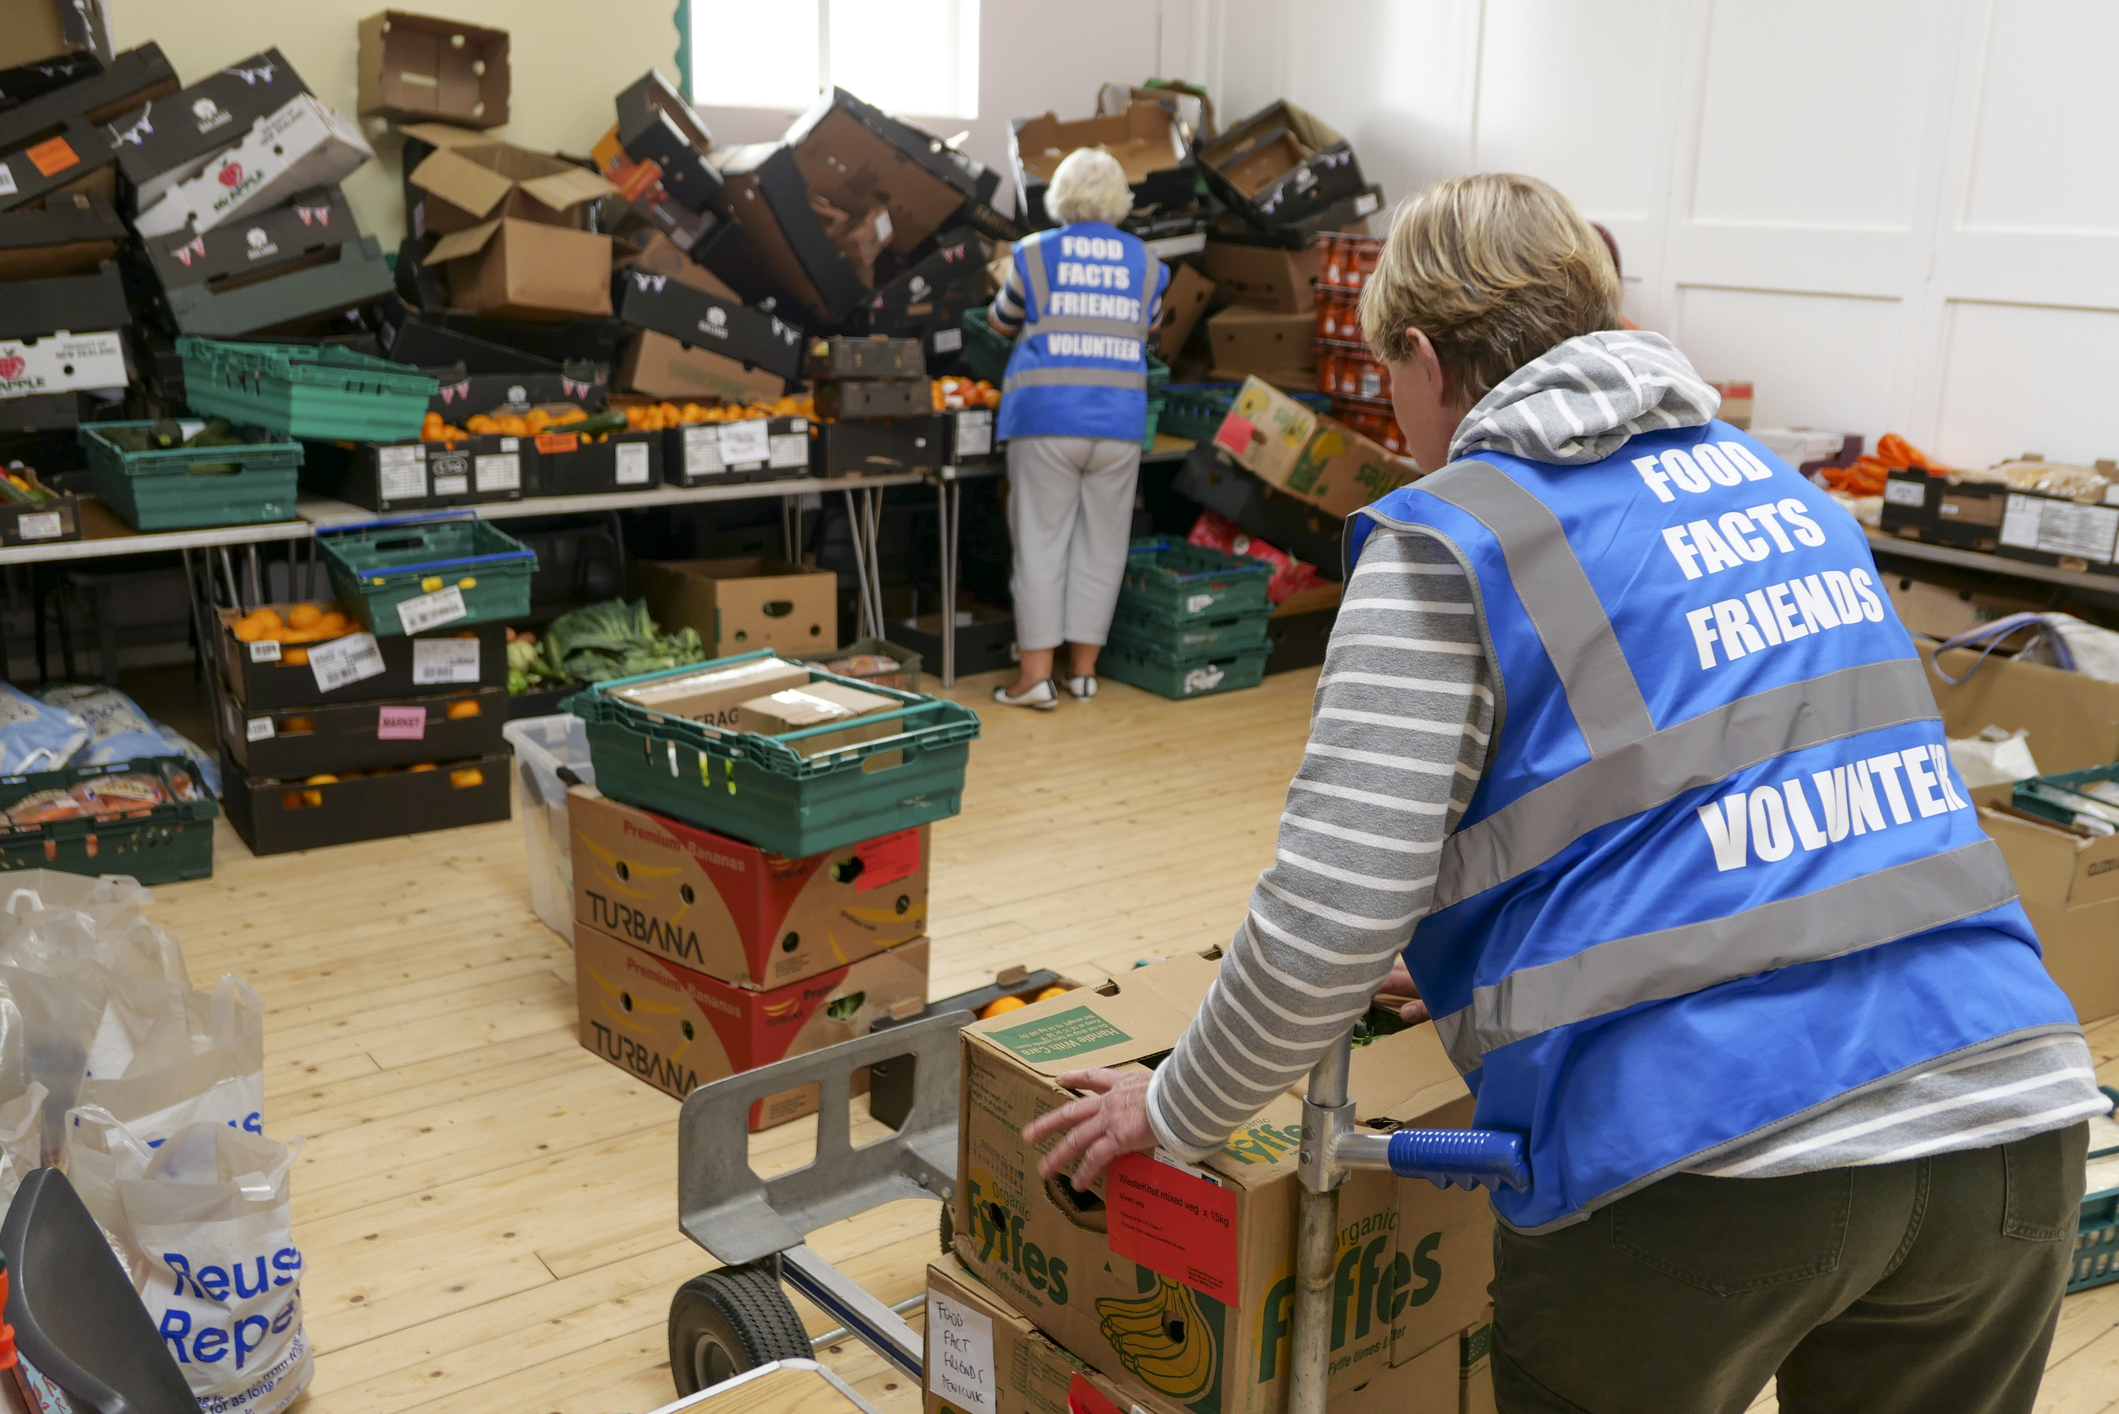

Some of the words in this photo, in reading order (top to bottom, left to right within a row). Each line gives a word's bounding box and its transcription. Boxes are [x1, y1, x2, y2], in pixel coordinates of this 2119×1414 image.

[229, 168, 265, 200] APPLE
[1061, 235, 1124, 261] FOOD
[1057, 261, 1131, 290] FACTS
[1050, 291, 1141, 323] FRIENDS
[1047, 332, 1142, 363] VOLUNTEER
[1631, 440, 1773, 503] FOOD
[1661, 498, 1826, 581] FACTS
[1685, 567, 1885, 670] FRIENDS
[622, 819, 682, 852] Premium
[686, 840, 746, 873] Bananas
[585, 889, 705, 966] TURBANA
[626, 955, 682, 993] Premium
[687, 983, 742, 1018] Bananas
[1020, 1046, 1052, 1056] Care
[1049, 1039, 1081, 1052] With
[1077, 1028, 1120, 1043] Handle
[590, 1019, 700, 1096] TURBANA
[992, 1181, 1032, 1222] Organic
[1118, 1173, 1159, 1198] WasteKnot
[1160, 1189, 1183, 1207] mixed
[1184, 1200, 1200, 1216] veg
[1203, 1209, 1208, 1217] x
[1210, 1210, 1230, 1228] 15kg
[1119, 1192, 1134, 1204] Mixed
[1134, 1199, 1145, 1209] veg
[936, 1301, 964, 1328] FOOD
[1258, 1231, 1443, 1385] fffes
[159, 1298, 296, 1371] Repe
[943, 1330, 971, 1354] FACT
[1353, 1341, 1381, 1363] times
[231, 1394, 246, 1408] as
[246, 1379, 275, 1399] long
[941, 1373, 986, 1405] PENICUIK
